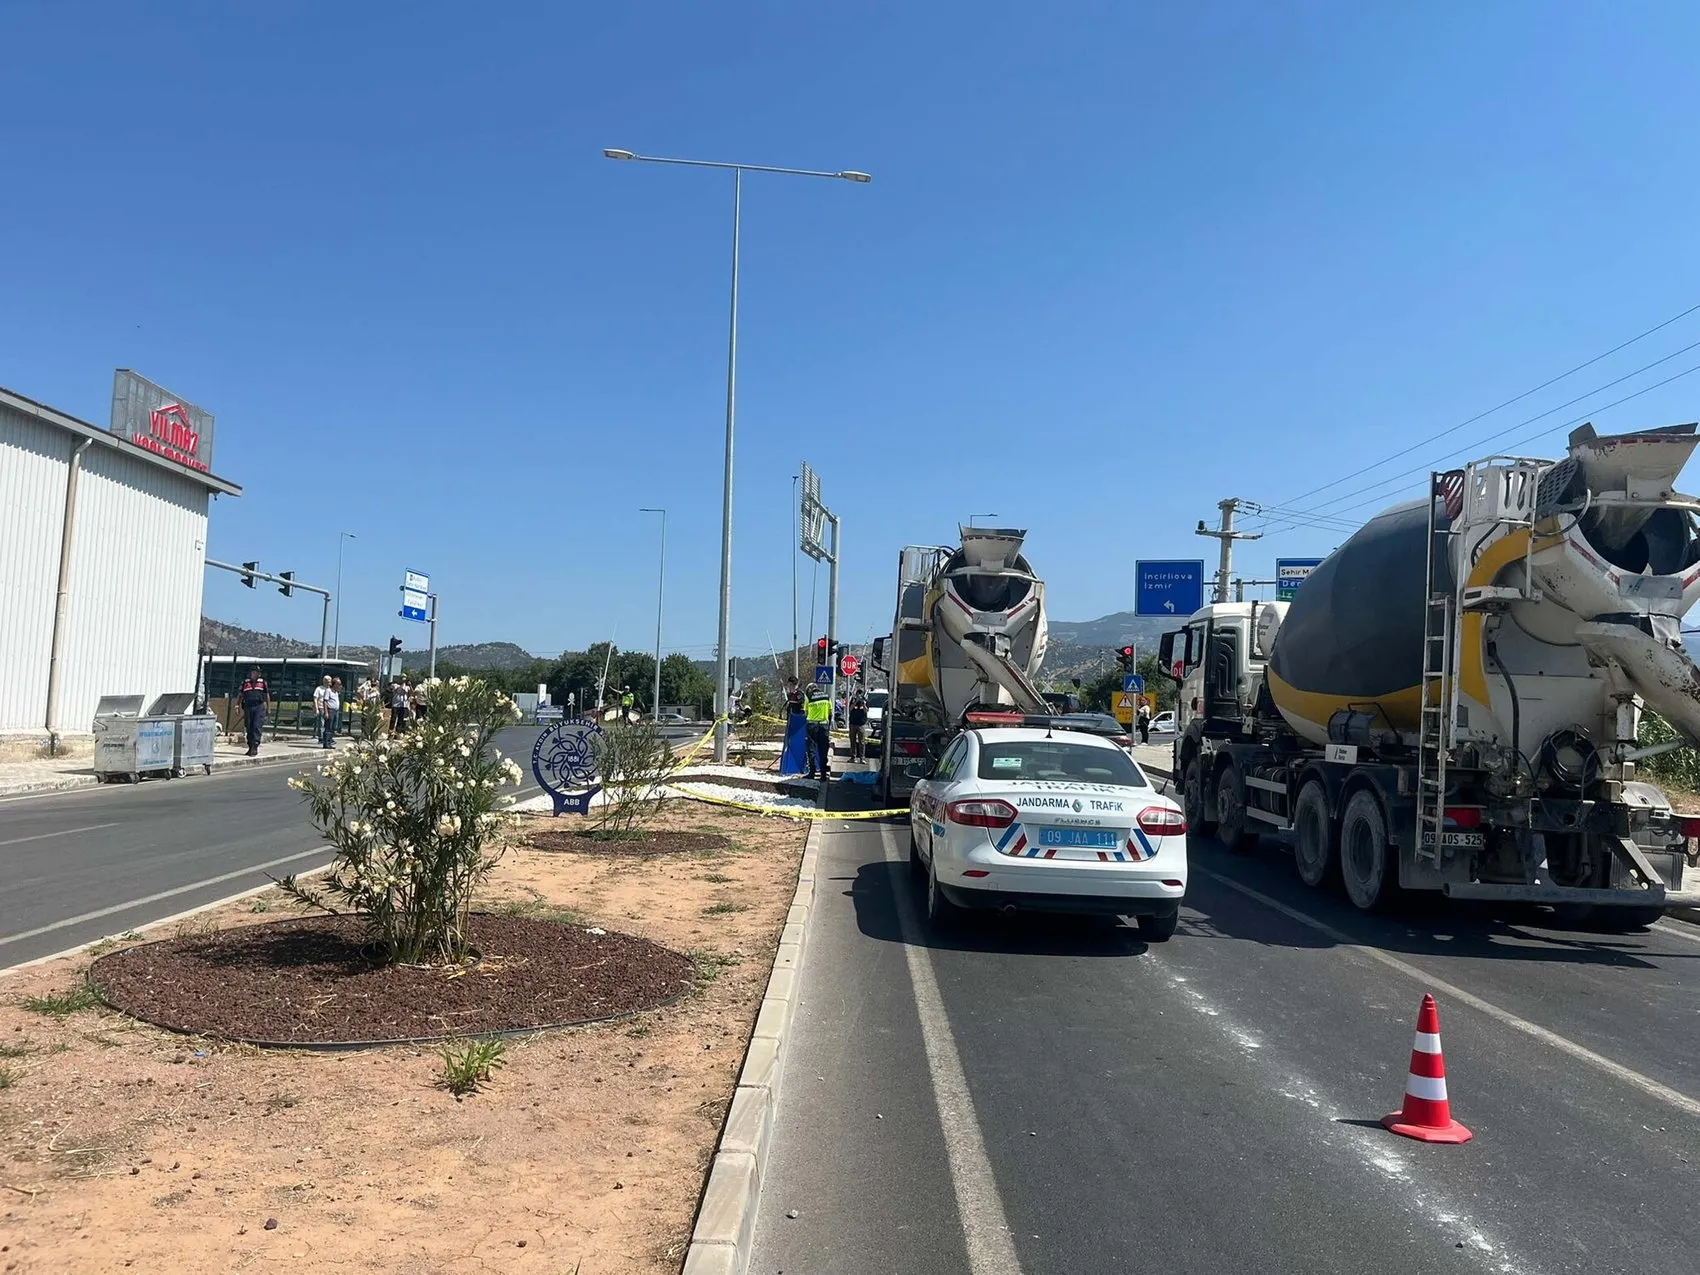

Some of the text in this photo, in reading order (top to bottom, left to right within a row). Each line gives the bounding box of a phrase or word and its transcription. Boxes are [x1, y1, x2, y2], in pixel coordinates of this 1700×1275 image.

[842, 660, 857, 669] DUR
[1016, 797, 1070, 809] JANDARMA
[1047, 830, 1116, 846] 09 JAA 111
